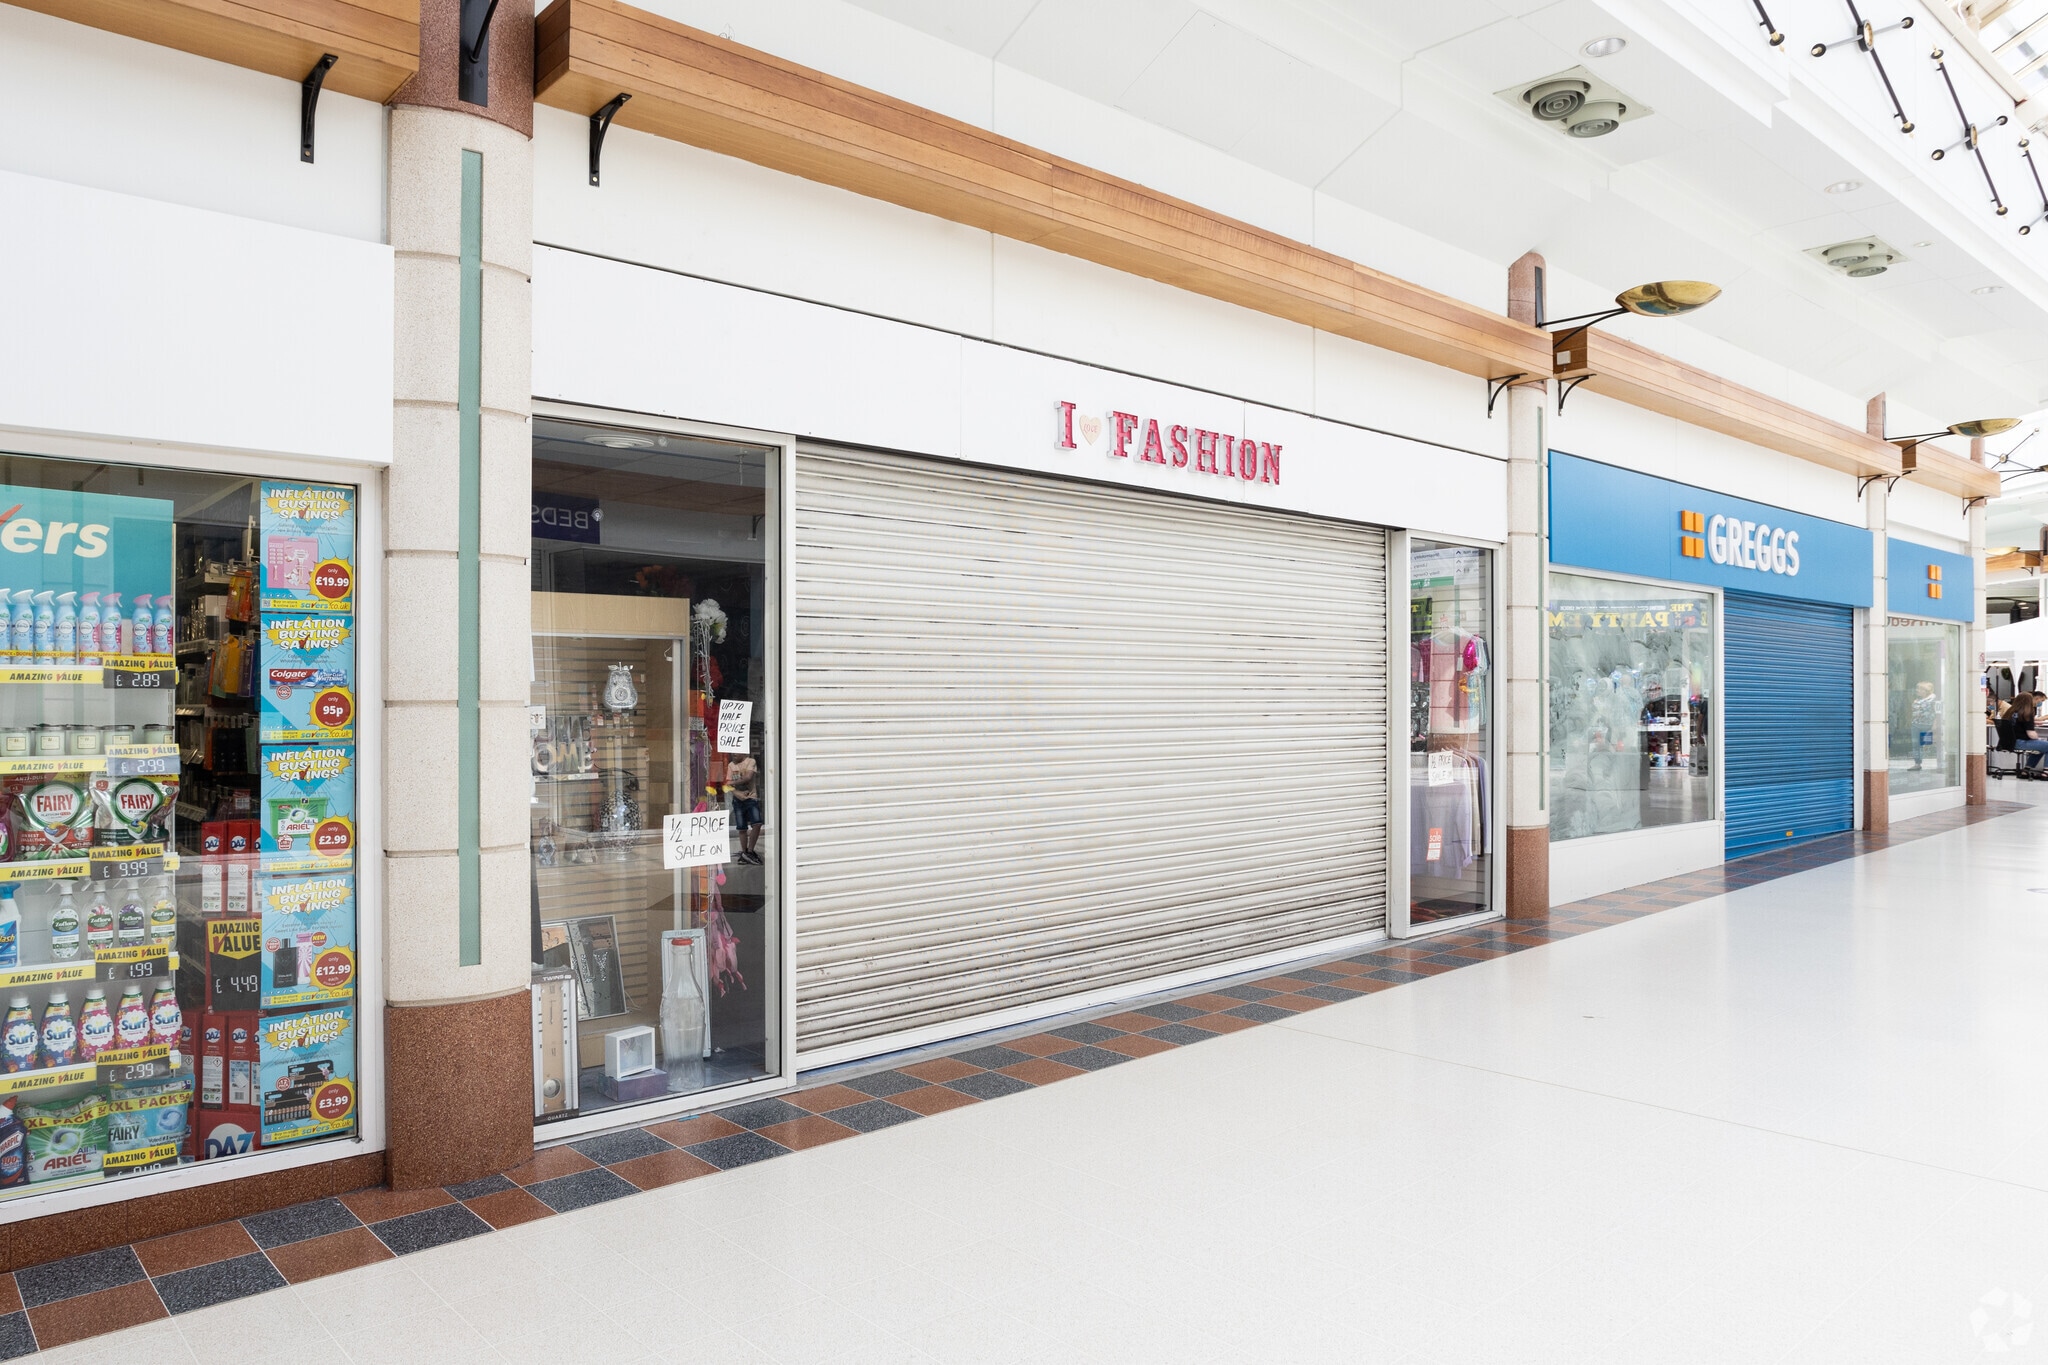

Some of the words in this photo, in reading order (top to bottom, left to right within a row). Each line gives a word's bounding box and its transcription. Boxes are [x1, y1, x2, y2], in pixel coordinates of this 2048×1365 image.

[1054, 400, 1077, 451] I
[1106, 410, 1283, 486] FASHION
[270, 489, 346, 500] INFLATION
[278, 500, 340, 509] BUSTING
[1707, 513, 1800, 577] GREGGS
[316, 576, 350, 587] £19.99
[270, 619, 346, 629] INFLATION
[278, 629, 340, 639] BUSTING
[105, 659, 145, 668] AMAZING
[148, 659, 174, 669] VALUE
[9, 673, 53, 681] AMAZING
[56, 672, 83, 681] VALUE
[131, 673, 160, 687] 2.89
[271, 670, 307, 679] Colgate
[322, 706, 343, 717] 95p
[720, 712, 741, 721] HALF
[718, 722, 746, 734] PRICE
[720, 735, 744, 748] SALE
[108, 747, 149, 755] AMAZING
[152, 746, 177, 755] VALUE
[271, 749, 346, 761] INFLATION
[11, 763, 54, 771] AMAZING
[57, 762, 84, 771] VALUE
[137, 759, 165, 773] 2.99
[279, 758, 340, 771] BUSTING
[36, 794, 74, 812] FAIRY
[120, 794, 155, 810] FAIRY
[286, 823, 310, 831] ARIEL
[690, 815, 726, 837] PRICE
[204, 838, 219, 849] DAZ
[230, 838, 246, 849] DAZ
[319, 835, 347, 845] £2.99
[91, 849, 133, 859] AMAZING
[136, 846, 161, 857] VALUE
[675, 844, 707, 861] SALE
[709, 843, 723, 856] ON
[10, 868, 54, 878] AMAZING
[57, 866, 83, 876] VALUE
[119, 861, 148, 877] 9.99
[271, 878, 347, 895] INFLATION
[280, 889, 341, 904] BUSTING
[212, 922, 260, 934] AMAZING
[213, 932, 261, 955] VALUE
[97, 951, 138, 961] AMAZING
[141, 947, 166, 958] VALUE
[9, 973, 53, 984] AMAZING
[56, 969, 83, 980] VALUE
[130, 962, 153, 978] 1.99
[316, 965, 351, 976] £12.99
[230, 975, 258, 993] 4.49
[121, 1017, 148, 1031] Surf
[155, 1011, 180, 1025] Surf
[269, 1010, 344, 1033] INFLATION
[46, 1027, 73, 1041] Surf
[85, 1022, 112, 1035] Surf
[205, 1029, 220, 1040] DAZ
[232, 1030, 247, 1041] DAZ
[277, 1021, 339, 1041] BUSTING
[8, 1031, 35, 1045] Surf
[98, 1052, 139, 1064] AMAZING
[142, 1047, 168, 1060] VALUE
[125, 1062, 154, 1080] 2.99
[11, 1076, 55, 1090] AMAZING
[58, 1071, 85, 1084] VALUE
[139, 1095, 178, 1108] PACK
[319, 1096, 349, 1109] £3.99
[24, 1118, 47, 1128] XL
[53, 1110, 94, 1125] PACK
[108, 1126, 140, 1141] FAIRY
[204, 1131, 257, 1160] DAZ
[43, 1154, 91, 1171] ARIEL
[105, 1152, 146, 1165] AMAZING
[149, 1147, 175, 1160] VALUE
